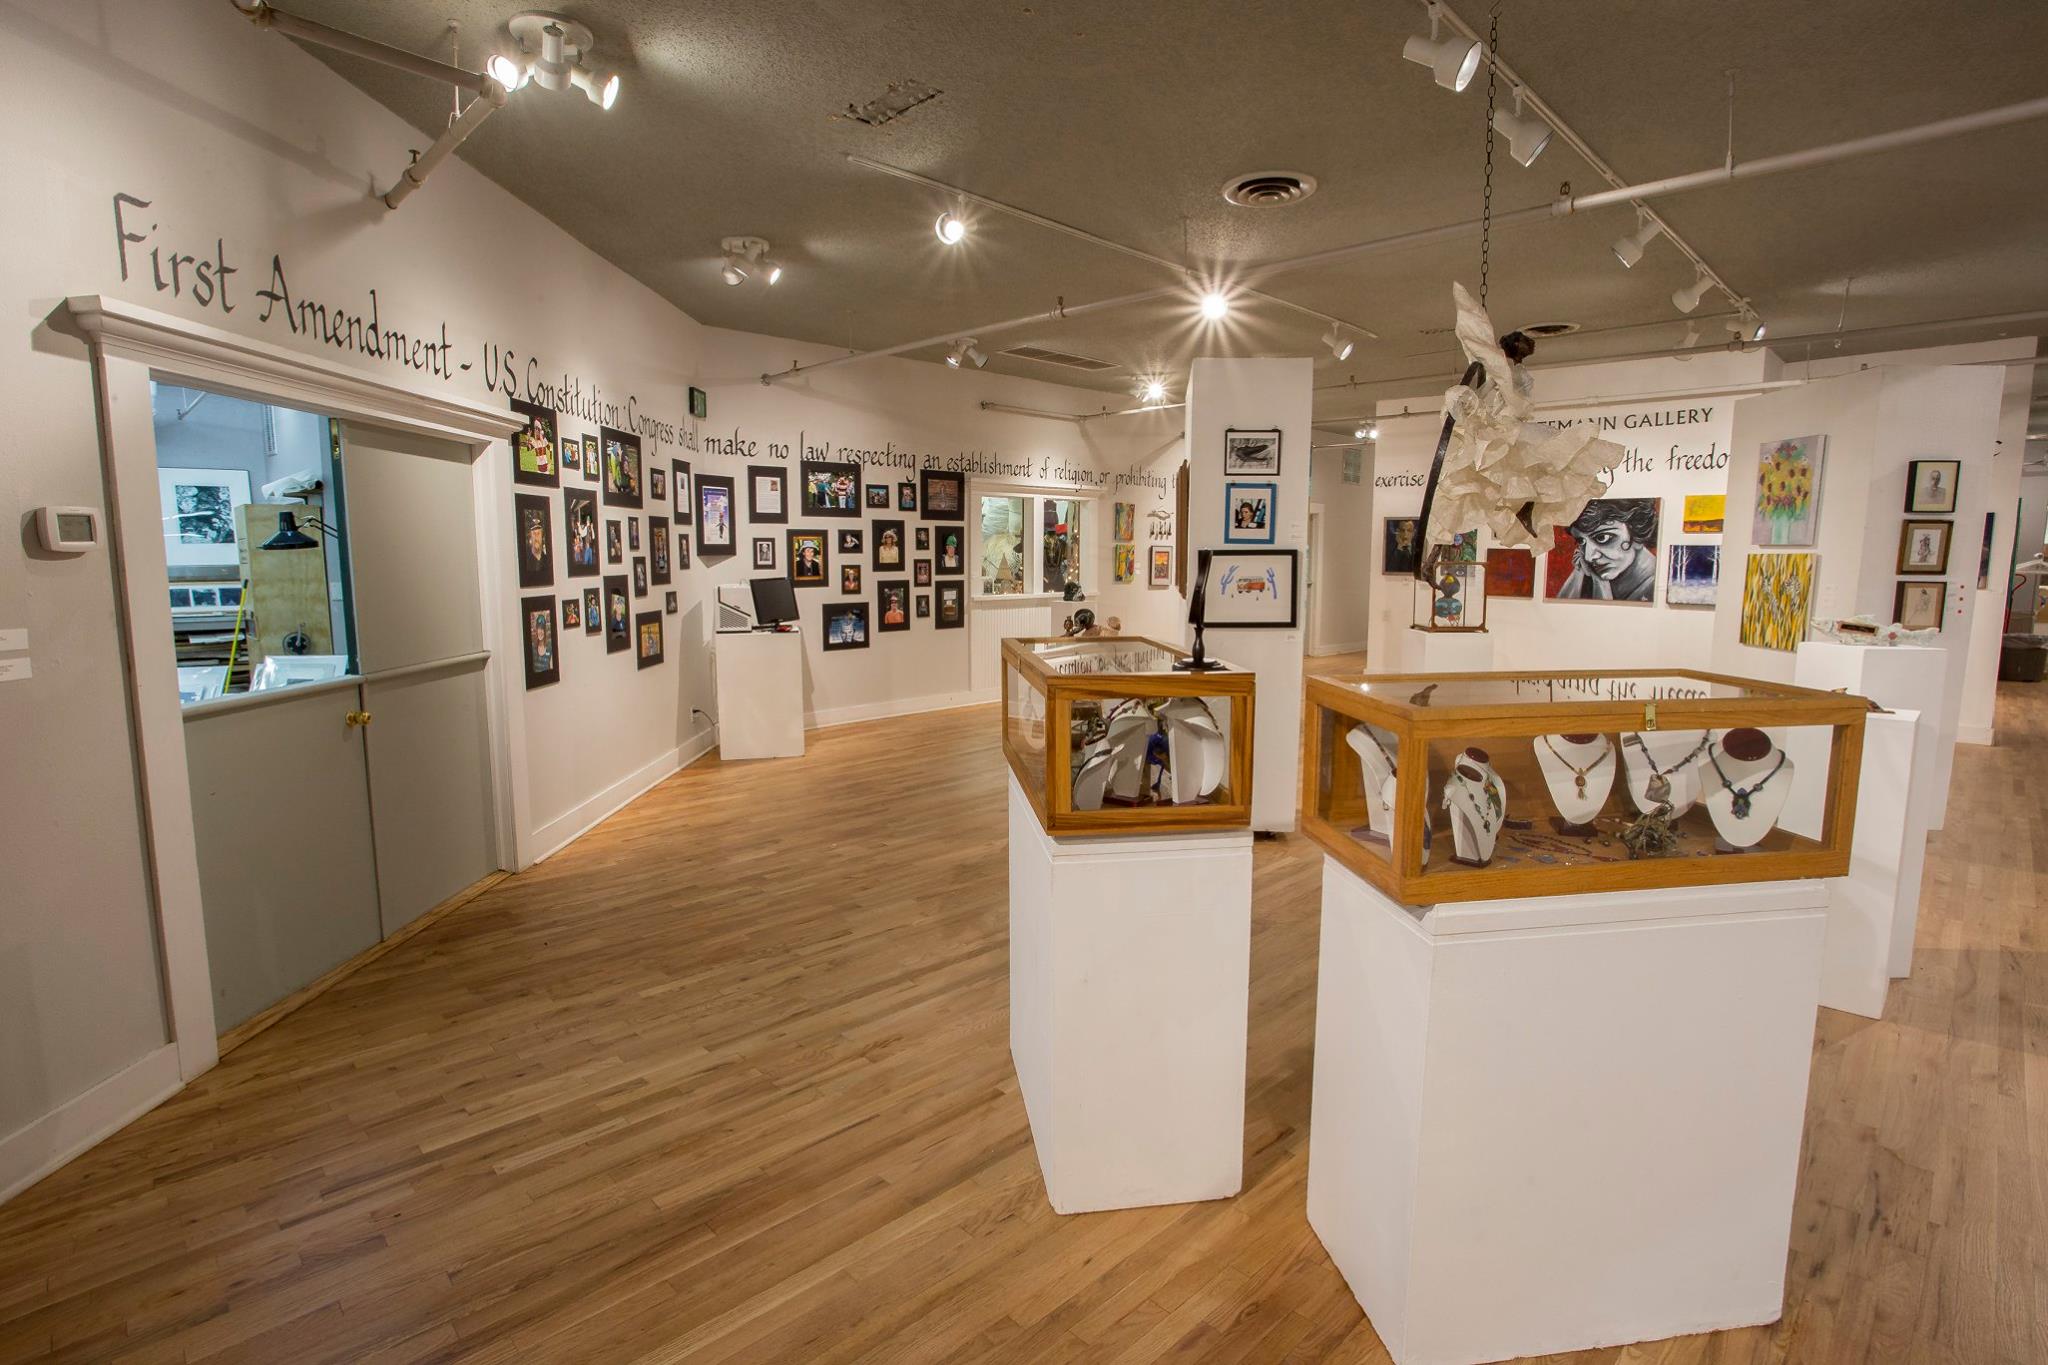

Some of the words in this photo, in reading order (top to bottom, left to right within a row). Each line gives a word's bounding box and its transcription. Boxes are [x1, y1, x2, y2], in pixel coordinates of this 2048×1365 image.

[113, 192, 238, 313] First
[256, 254, 453, 380] Amendment
[484, 341, 521, 399] U.S.
[628, 395, 674, 457] Congress
[679, 415, 699, 453] shall
[1623, 407, 1713, 429] GALLERY
[704, 426, 759, 457] make
[767, 440, 789, 460] no
[800, 430, 830, 462] law
[838, 442, 916, 482] respecting
[923, 453, 942, 470] an
[946, 450, 1033, 478] establishment
[1039, 456, 1050, 480] of
[1099, 470, 1110, 484] or
[1115, 464, 1167, 499] prohibiting
[1375, 469, 1425, 488] exercise
[1622, 447, 1654, 473] the
